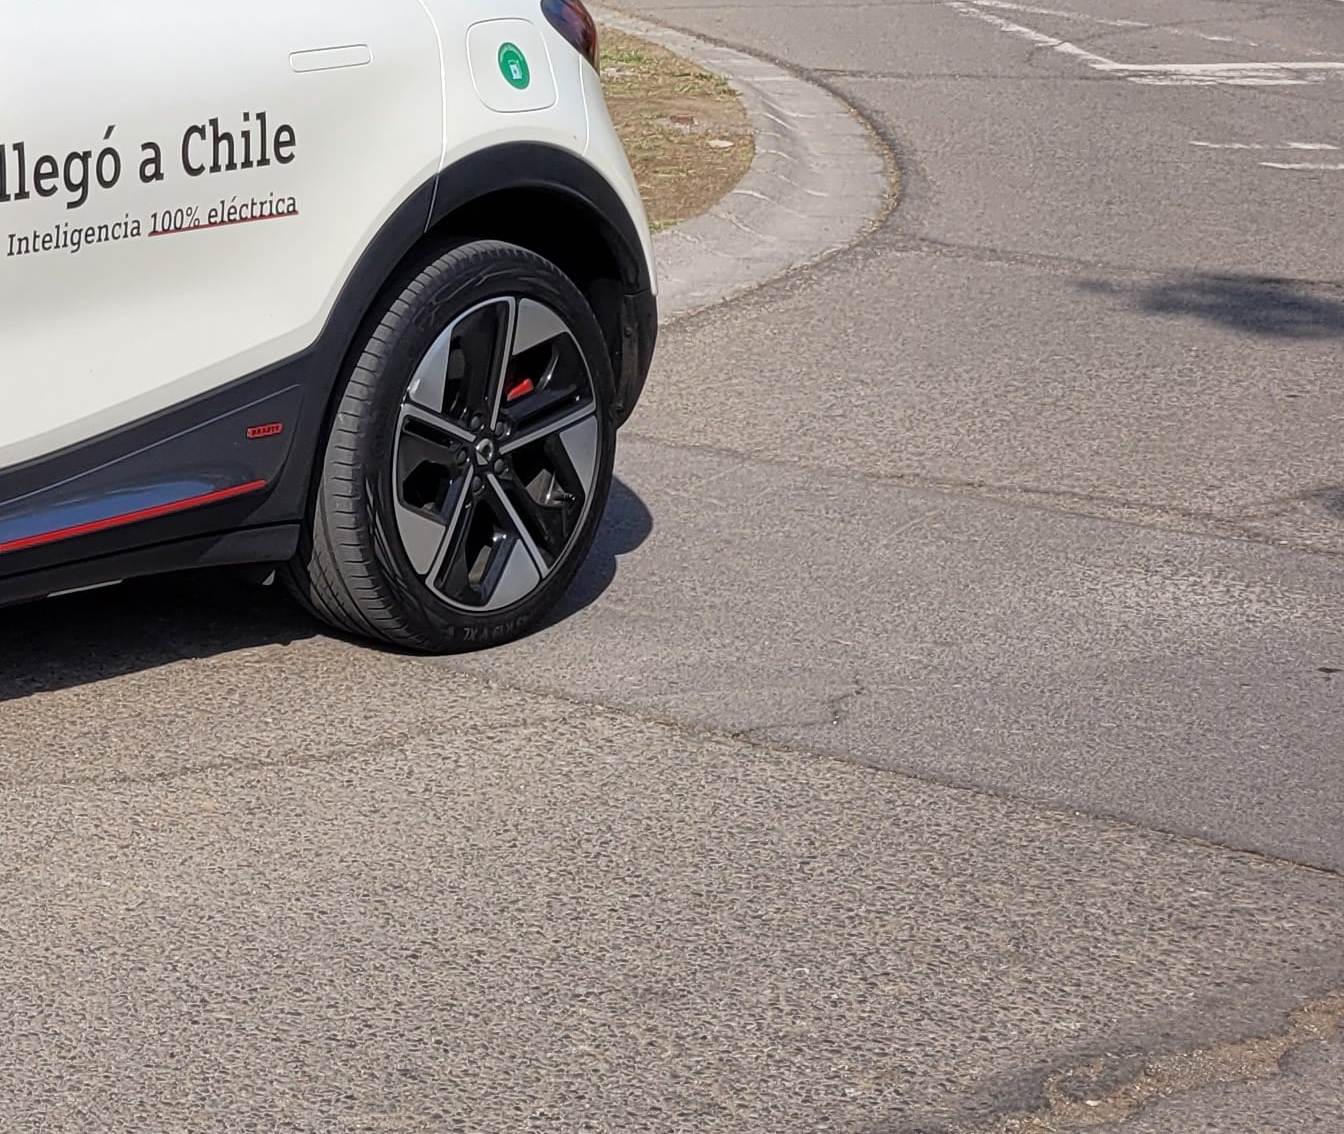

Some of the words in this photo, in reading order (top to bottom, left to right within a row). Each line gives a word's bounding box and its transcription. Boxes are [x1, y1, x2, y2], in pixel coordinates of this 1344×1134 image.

[139, 139, 164, 183] a
[181, 110, 297, 178] Chile
[6, 214, 142, 257] Inteligencia
[149, 205, 201, 236] 100%
[207, 192, 298, 228] eléctrica
